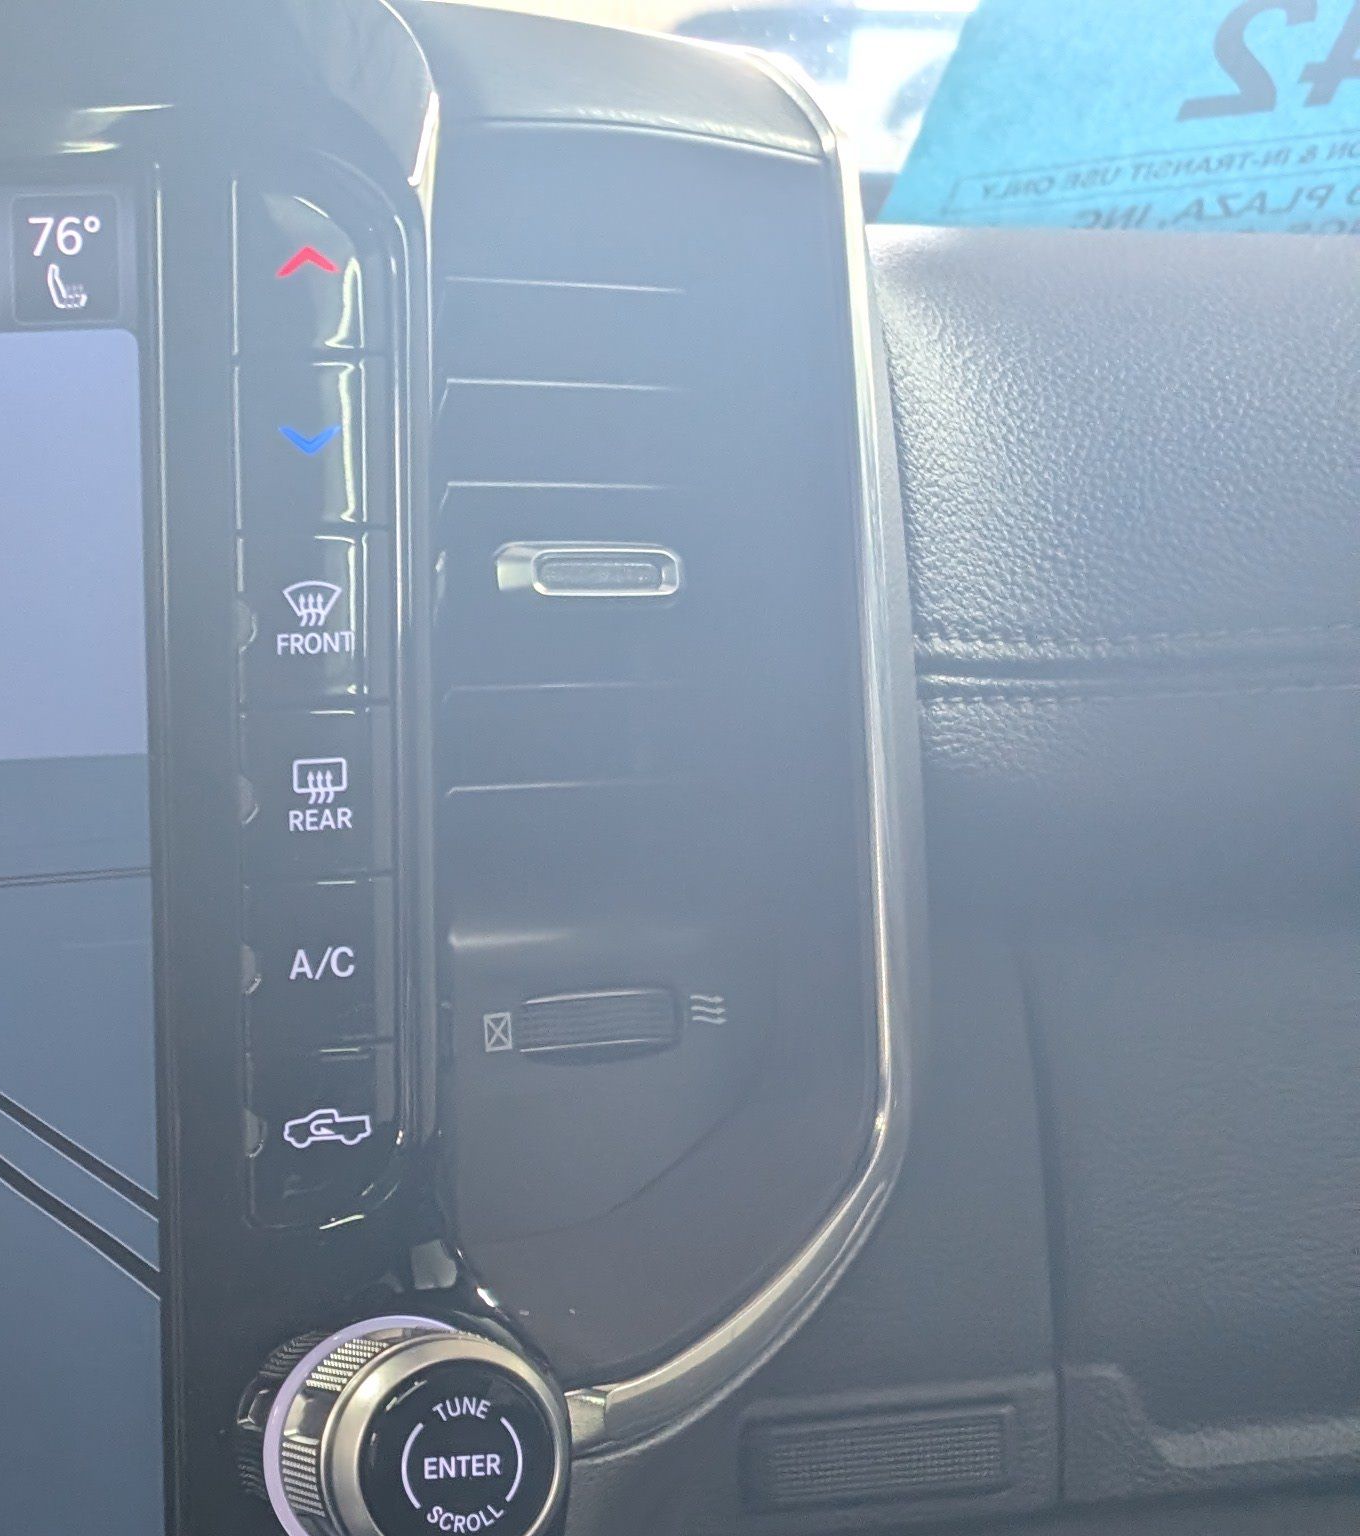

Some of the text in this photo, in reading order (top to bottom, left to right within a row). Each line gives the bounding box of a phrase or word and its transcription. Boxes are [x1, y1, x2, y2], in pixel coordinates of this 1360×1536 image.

[27, 214, 101, 257] 76°
[276, 631, 354, 656] FRONT
[288, 808, 352, 832] REAR
[288, 946, 355, 981] A/C
[432, 1396, 491, 1422] TUNE
[423, 1454, 501, 1480] ENTER
[426, 1504, 504, 1534] SCROLL
